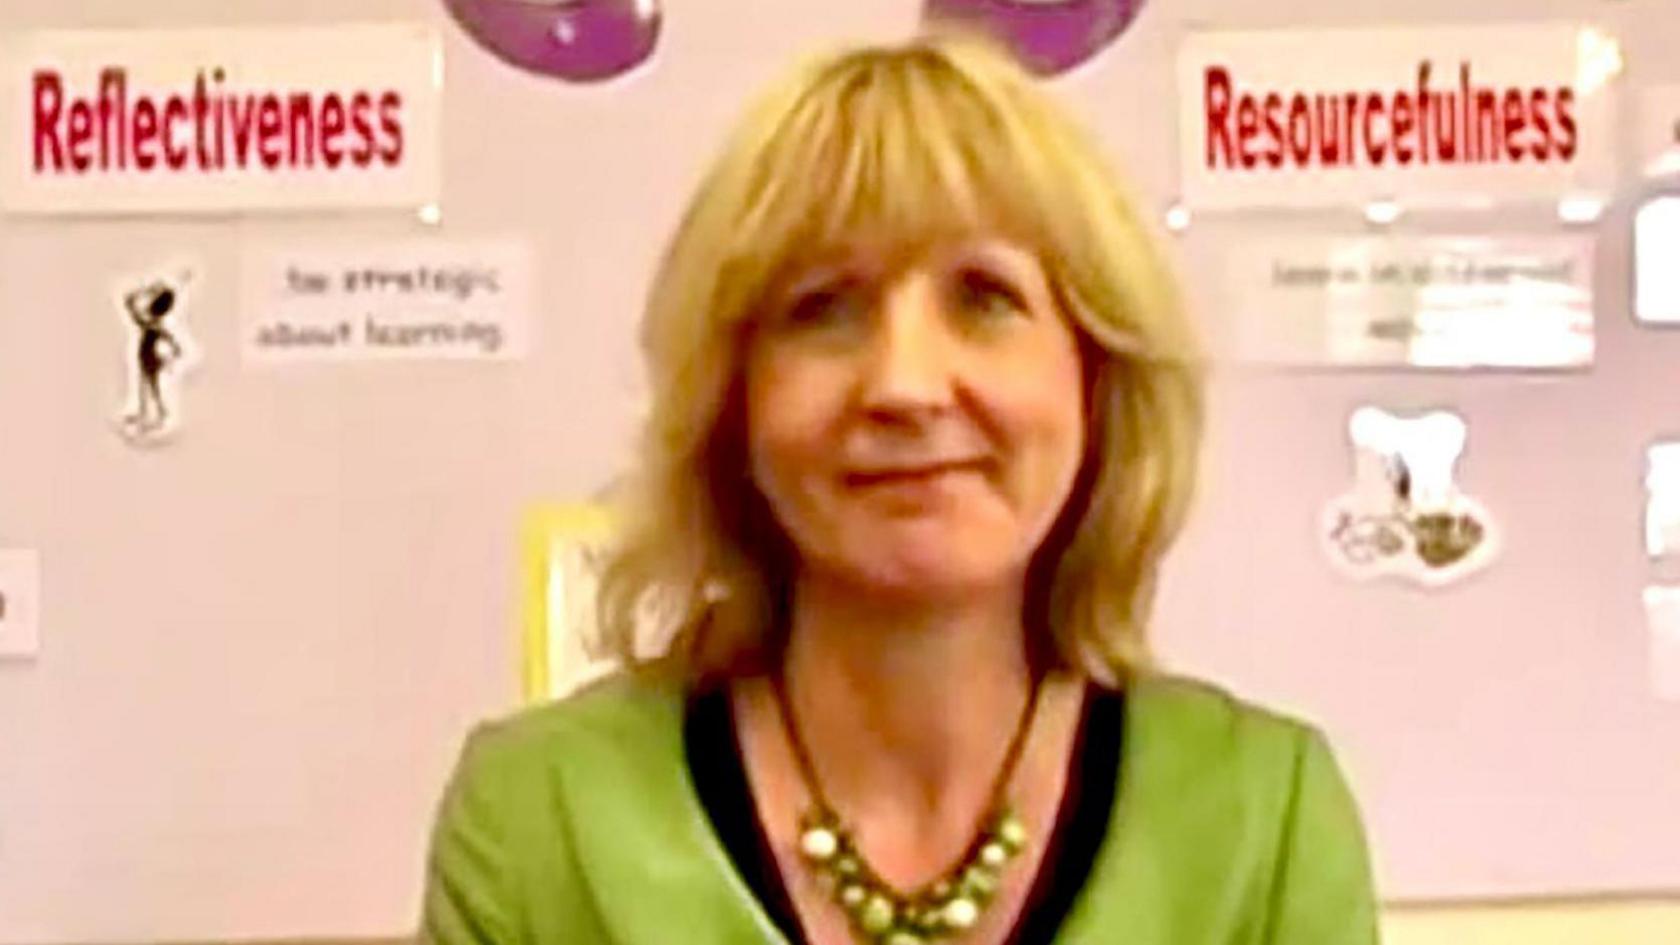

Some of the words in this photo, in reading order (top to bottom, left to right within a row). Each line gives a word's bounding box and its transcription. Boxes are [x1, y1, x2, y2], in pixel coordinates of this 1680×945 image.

[33, 67, 403, 173] Reflectiveness
[1204, 60, 1578, 168] Resourcefulness
[344, 266, 501, 301] strategic
[257, 320, 352, 347] about
[364, 314, 502, 352] learning
